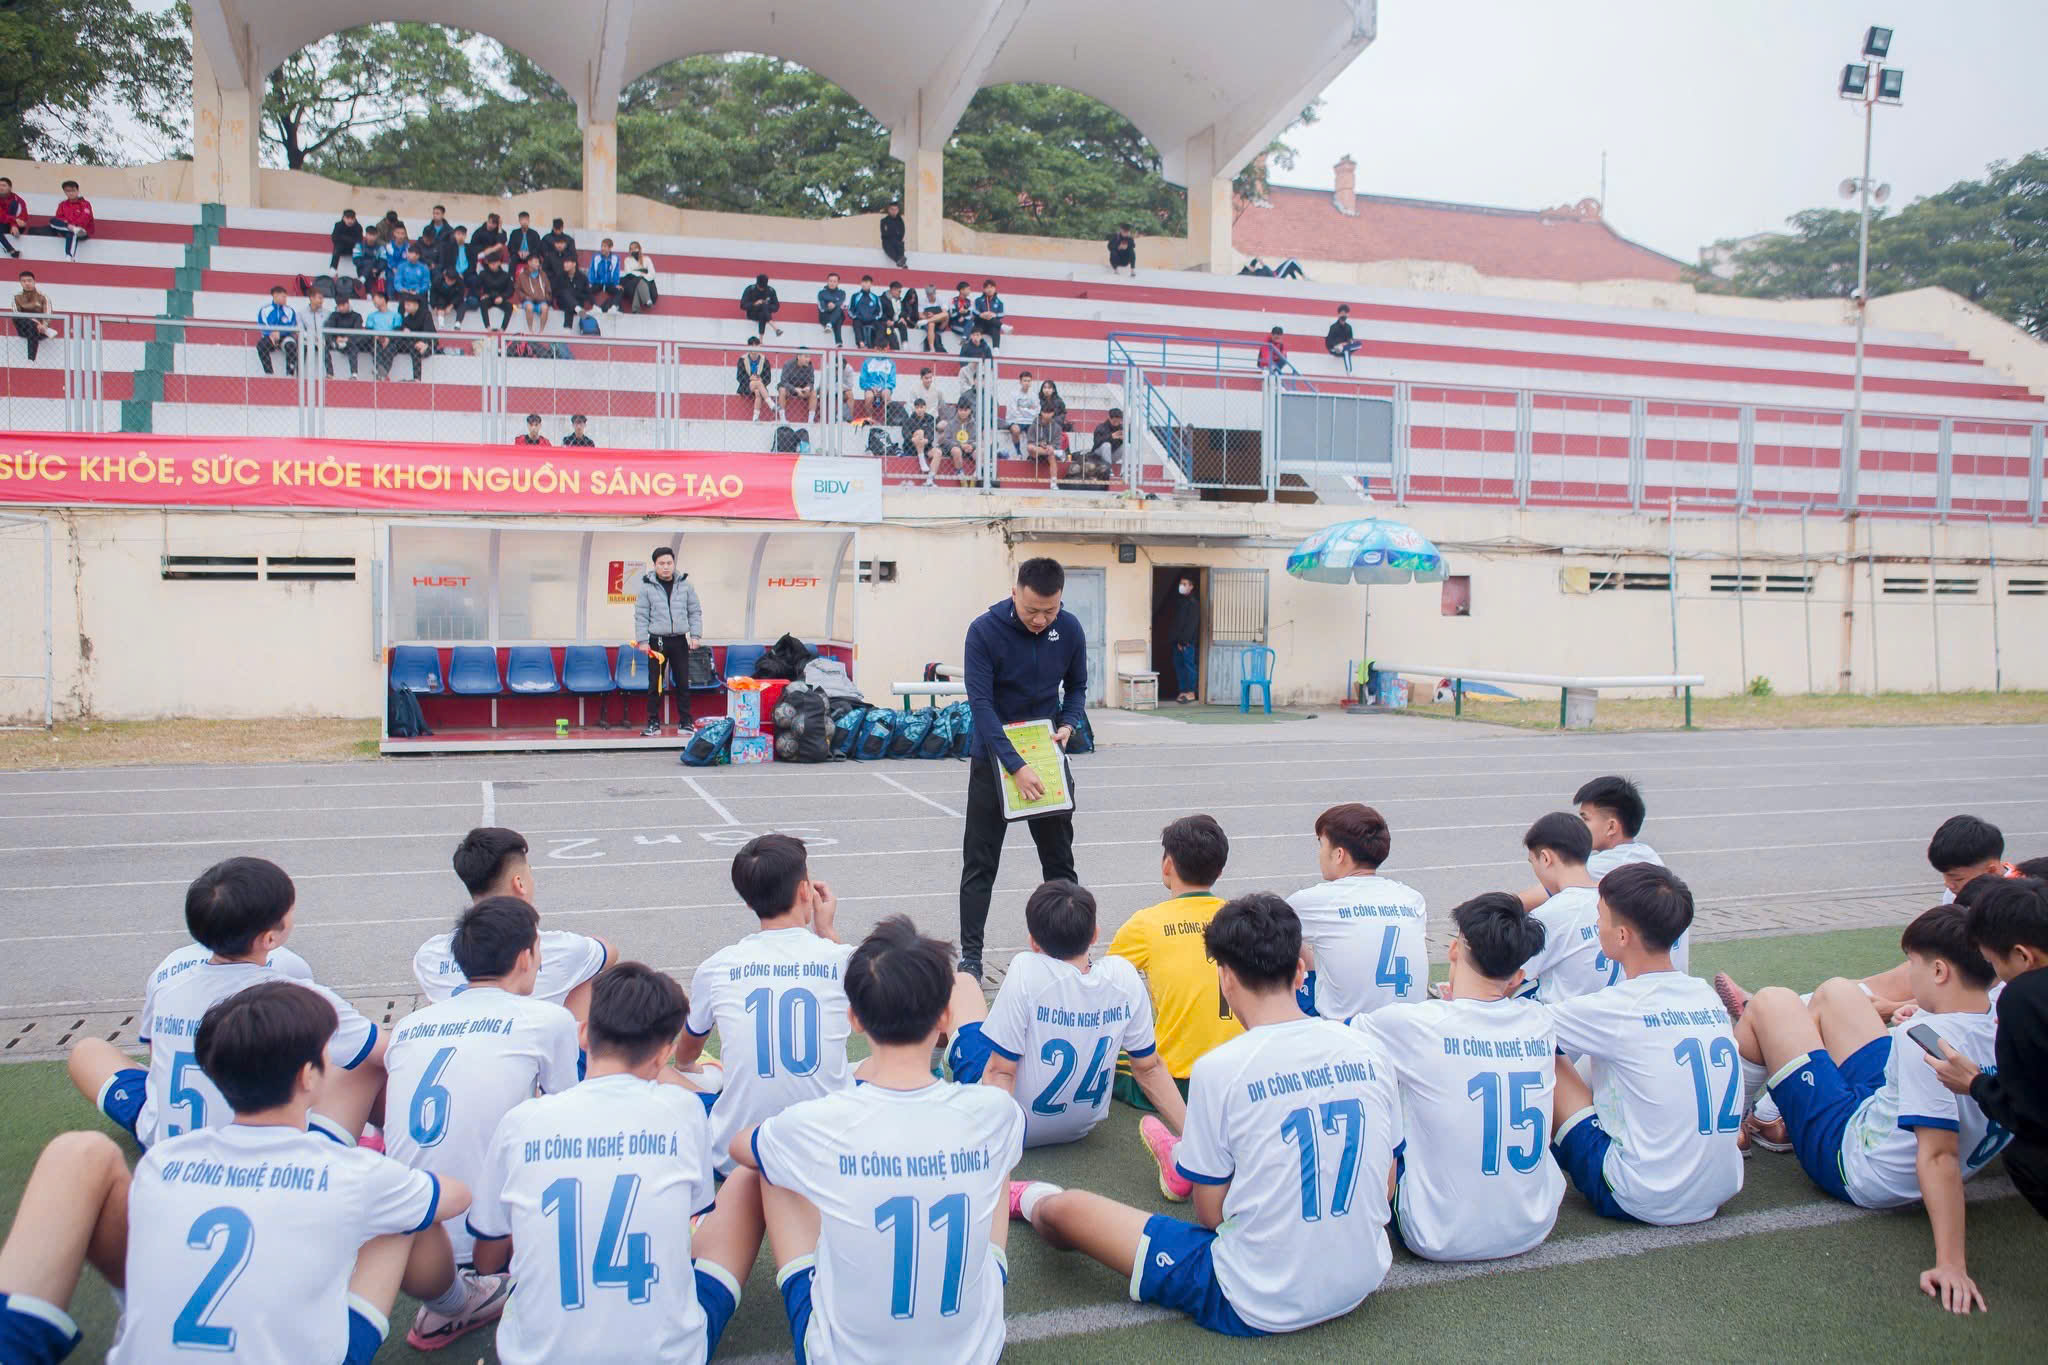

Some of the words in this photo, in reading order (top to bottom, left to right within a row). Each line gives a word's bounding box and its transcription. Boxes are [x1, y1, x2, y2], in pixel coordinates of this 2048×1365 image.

[0, 449, 68, 481] SỨC
[80, 450, 183, 486] KHỎE,
[191, 453, 261, 485] SỨC
[272, 455, 362, 488] KHỎE
[589, 465, 677, 497] SÁNG
[683, 473, 744, 501] TẠO
[814, 479, 850, 494] BIDV
[412, 575, 472, 587] HUST
[767, 576, 822, 588] HUST
[1353, 903, 1378, 917] CÔNG
[743, 961, 771, 978] CÔNG
[773, 961, 800, 980] NGHỆ
[1375, 925, 1413, 998] 4
[408, 1022, 436, 1041] CÔNG
[437, 1019, 469, 1038] NGHỆ
[745, 987, 822, 1079] 10
[1051, 1006, 1076, 1027] CÔNG
[1660, 1008, 1690, 1026] CÔNG
[1463, 1036, 1493, 1058] CÔNG
[1495, 1037, 1524, 1062] NGHỆ
[168, 1050, 208, 1137] 5
[1031, 1035, 1114, 1117] 24
[1267, 1072, 1303, 1097] CÔNG
[1301, 1062, 1335, 1089] NGHỆ
[1673, 1036, 1744, 1136] 12
[408, 1046, 458, 1149] 6
[1467, 1071, 1546, 1176] 15
[545, 1134, 582, 1160] CÔNG
[586, 1131, 625, 1161] NGHỆ
[1280, 1098, 1366, 1223] 17
[182, 1158, 225, 1187] CÔNG
[224, 1163, 269, 1193] NGHỆ
[861, 1151, 901, 1178] CÔNG
[906, 1150, 947, 1181] NGHỆ
[541, 1173, 660, 1312] 14
[875, 1192, 970, 1320] 11
[172, 1205, 255, 1352] 2
